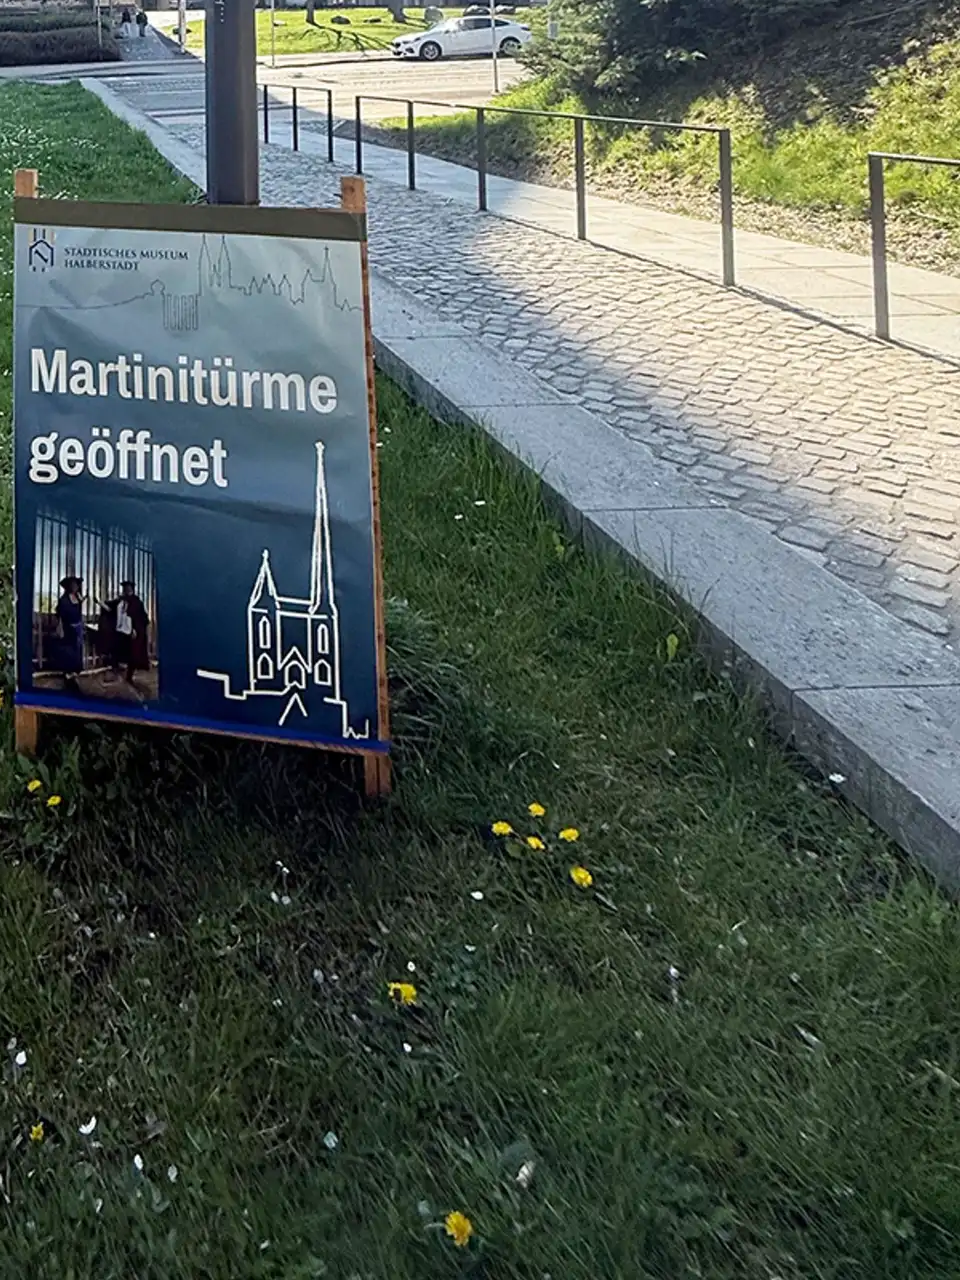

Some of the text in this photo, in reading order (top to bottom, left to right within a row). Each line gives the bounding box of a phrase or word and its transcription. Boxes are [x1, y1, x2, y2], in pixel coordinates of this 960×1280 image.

[63, 259, 139, 271] HALBERSTADT
[139, 250, 189, 260] MUSEUM
[30, 348, 338, 414] Martinitürme
[28, 427, 228, 488] geöffnet
